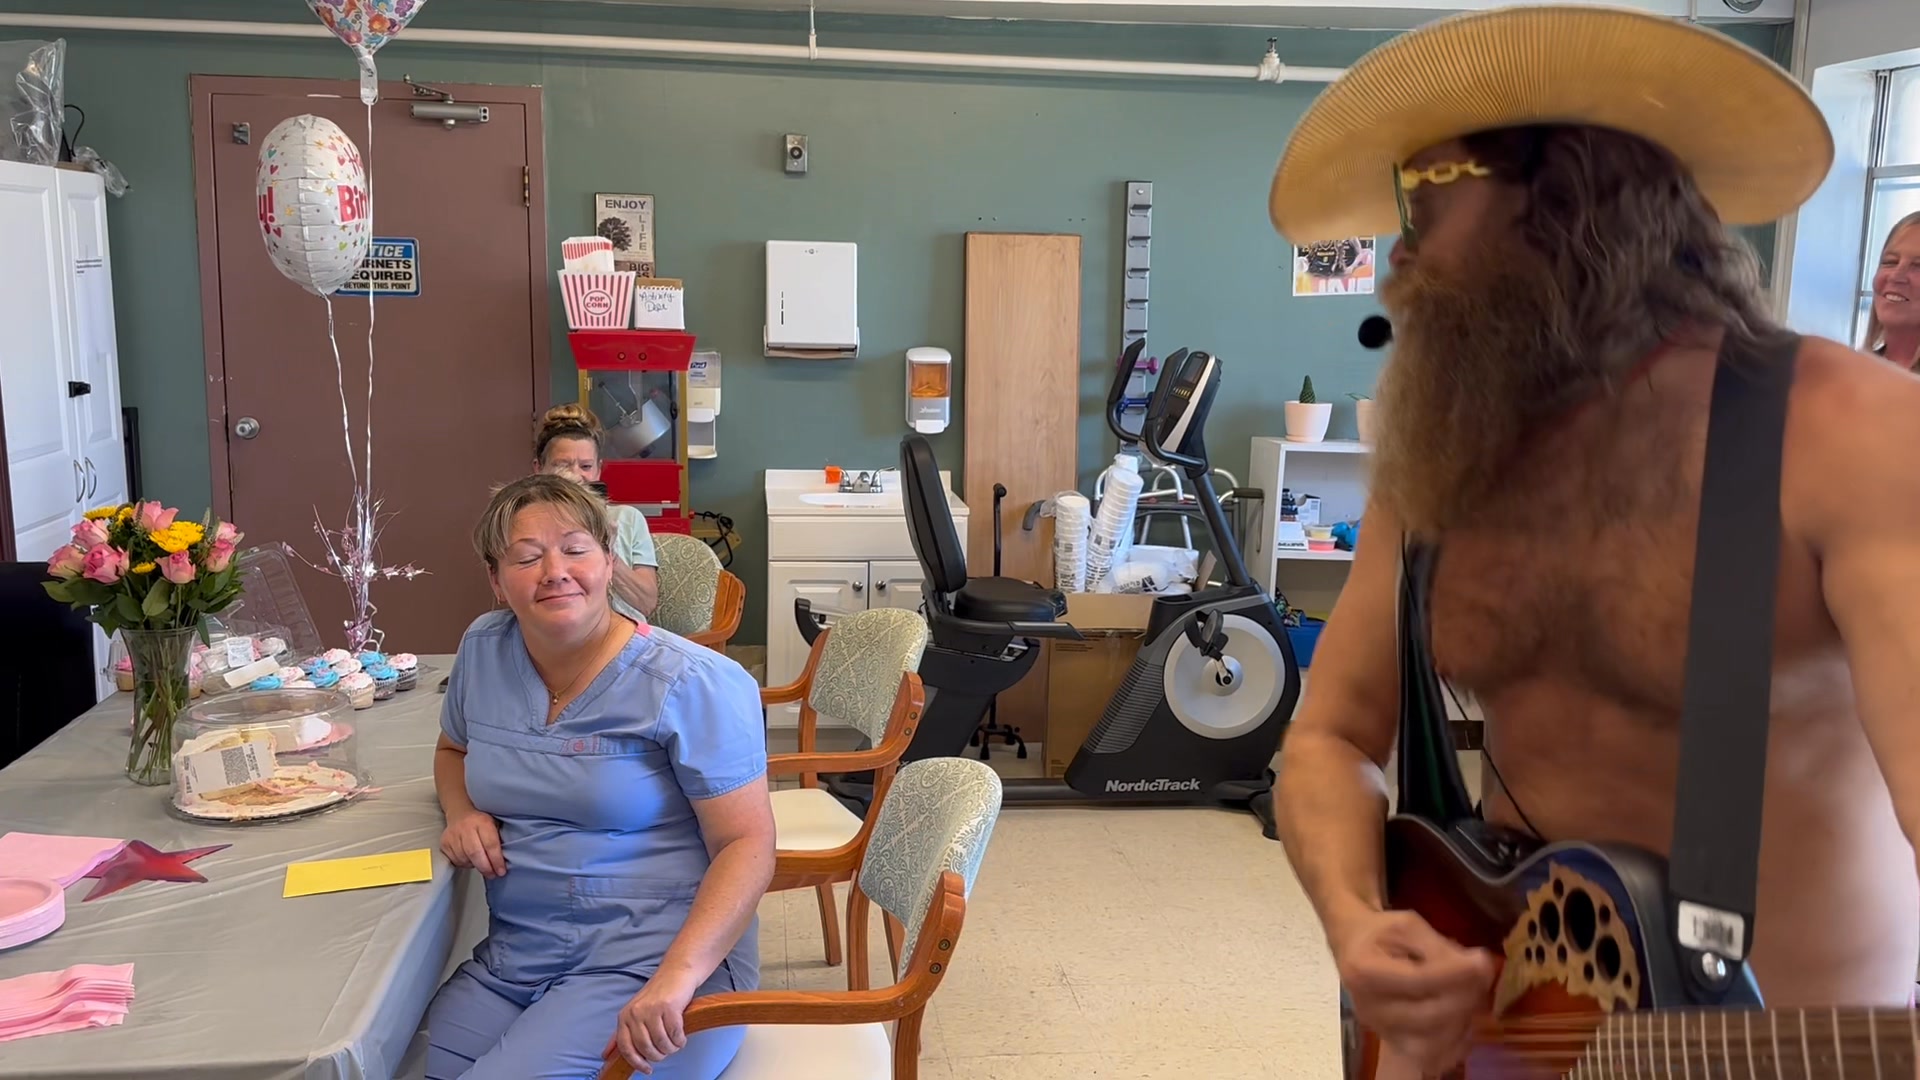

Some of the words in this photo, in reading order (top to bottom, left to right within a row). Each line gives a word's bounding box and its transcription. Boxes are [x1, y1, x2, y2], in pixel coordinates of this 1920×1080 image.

[605, 199, 647, 209] ENJOY
[639, 214, 647, 251] LIFE
[371, 245, 405, 257] TICE
[360, 259, 412, 269] IRNETS
[629, 263, 650, 272] BIG
[351, 270, 413, 280] EQUIRED
[344, 282, 370, 290] BEYOND
[373, 282, 389, 290] THIS
[391, 282, 411, 290] POINT
[1105, 778, 1201, 792] NordicTrack
